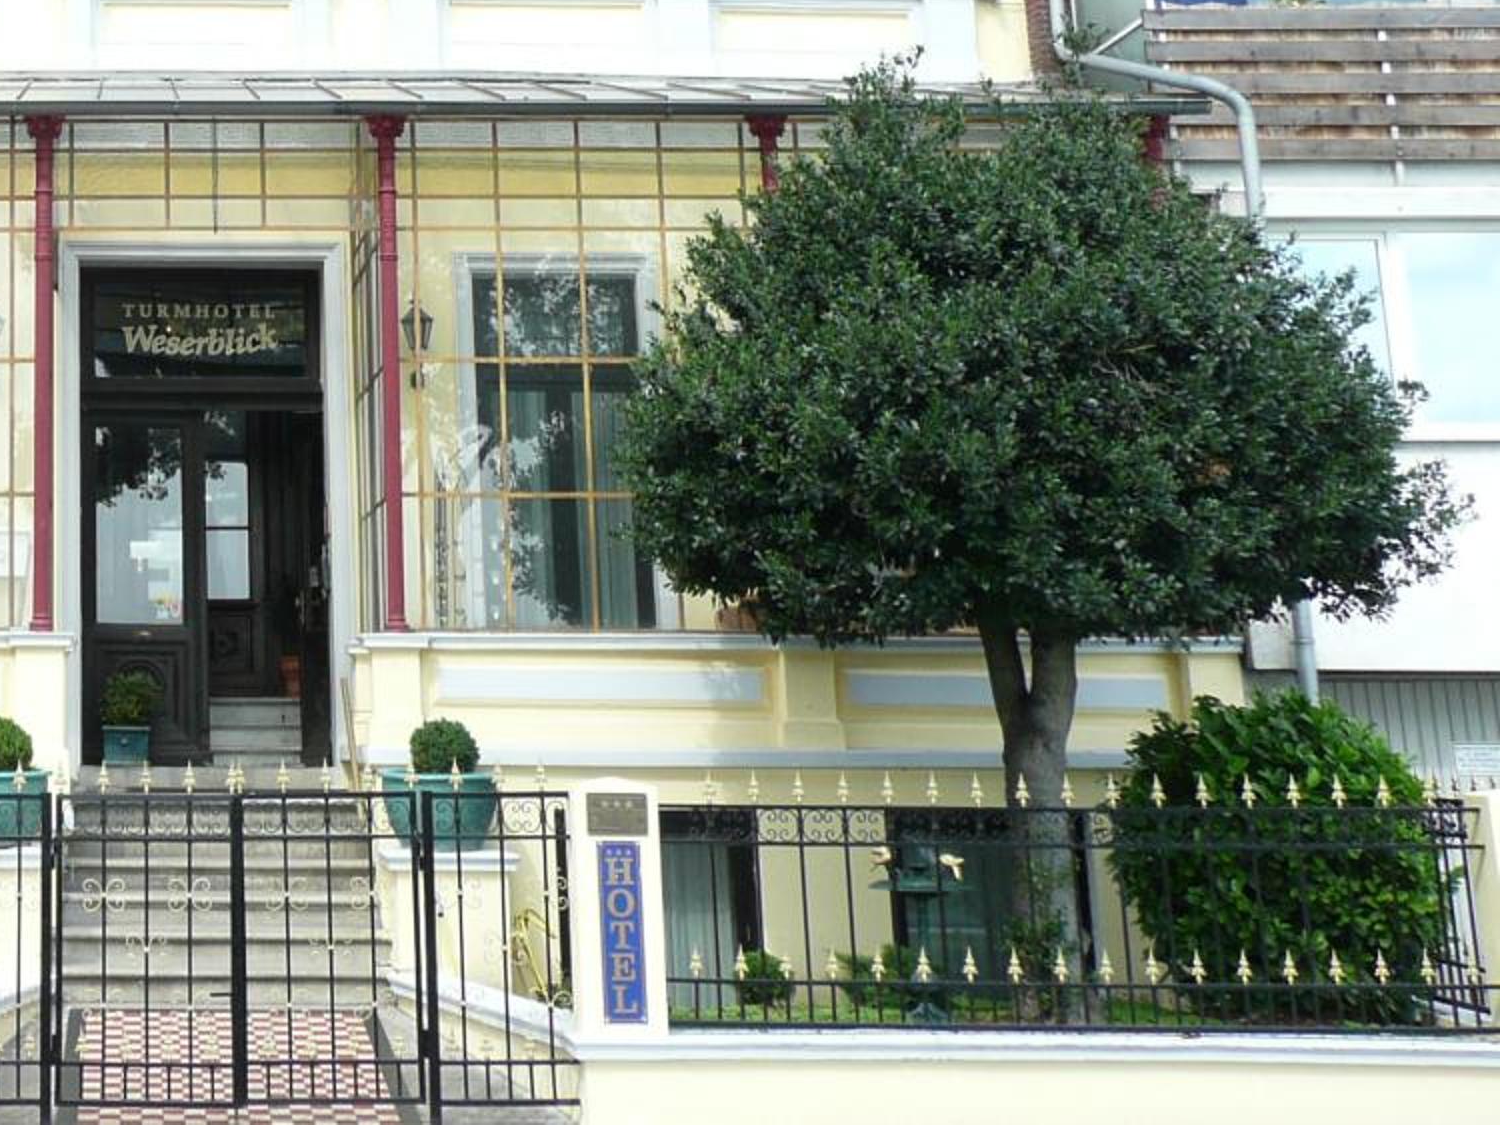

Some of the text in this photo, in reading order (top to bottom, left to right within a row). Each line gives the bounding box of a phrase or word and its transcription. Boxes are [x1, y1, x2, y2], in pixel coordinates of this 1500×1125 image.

[122, 303, 276, 319] TURMHOTEL
[122, 323, 277, 355] Weserblick
[604, 858, 638, 1014] HOTEL
